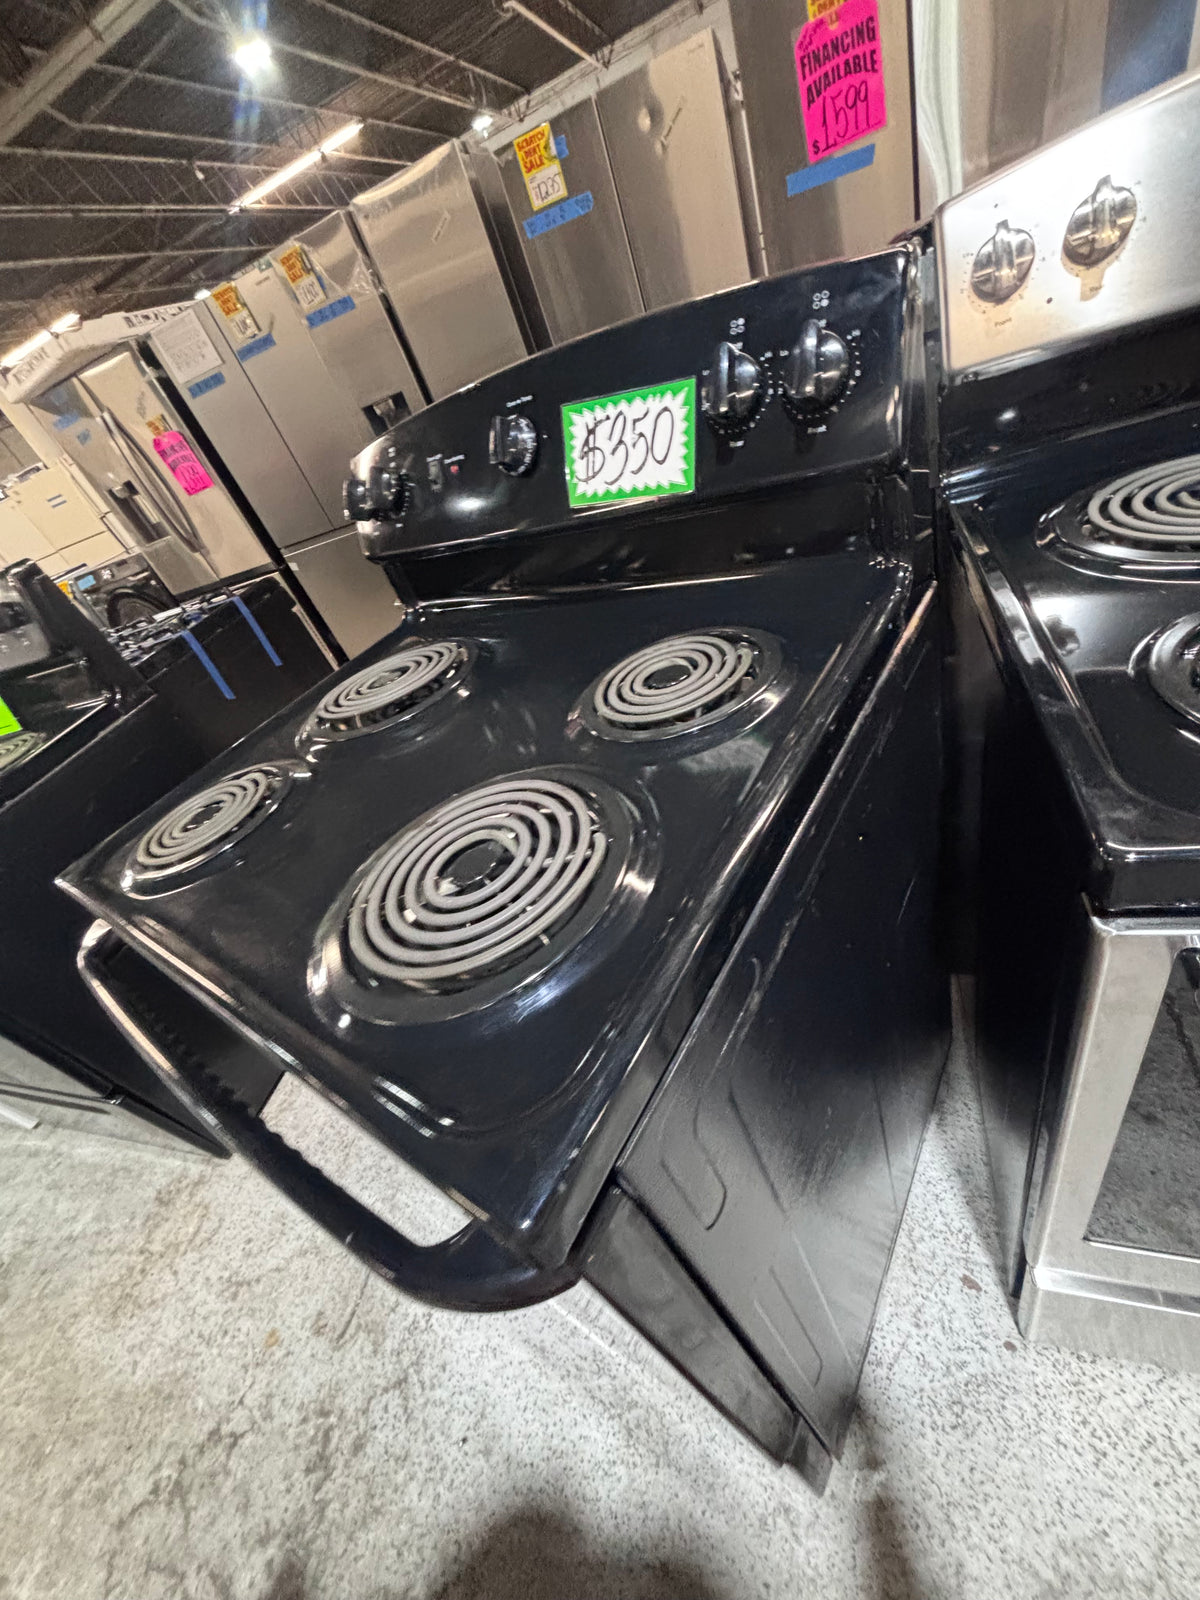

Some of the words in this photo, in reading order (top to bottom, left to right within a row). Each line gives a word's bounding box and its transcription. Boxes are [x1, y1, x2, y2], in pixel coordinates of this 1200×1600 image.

[799, 15, 877, 82] FINANCING
[806, 50, 879, 111] AVAILABLE
[575, 406, 674, 486] $350
